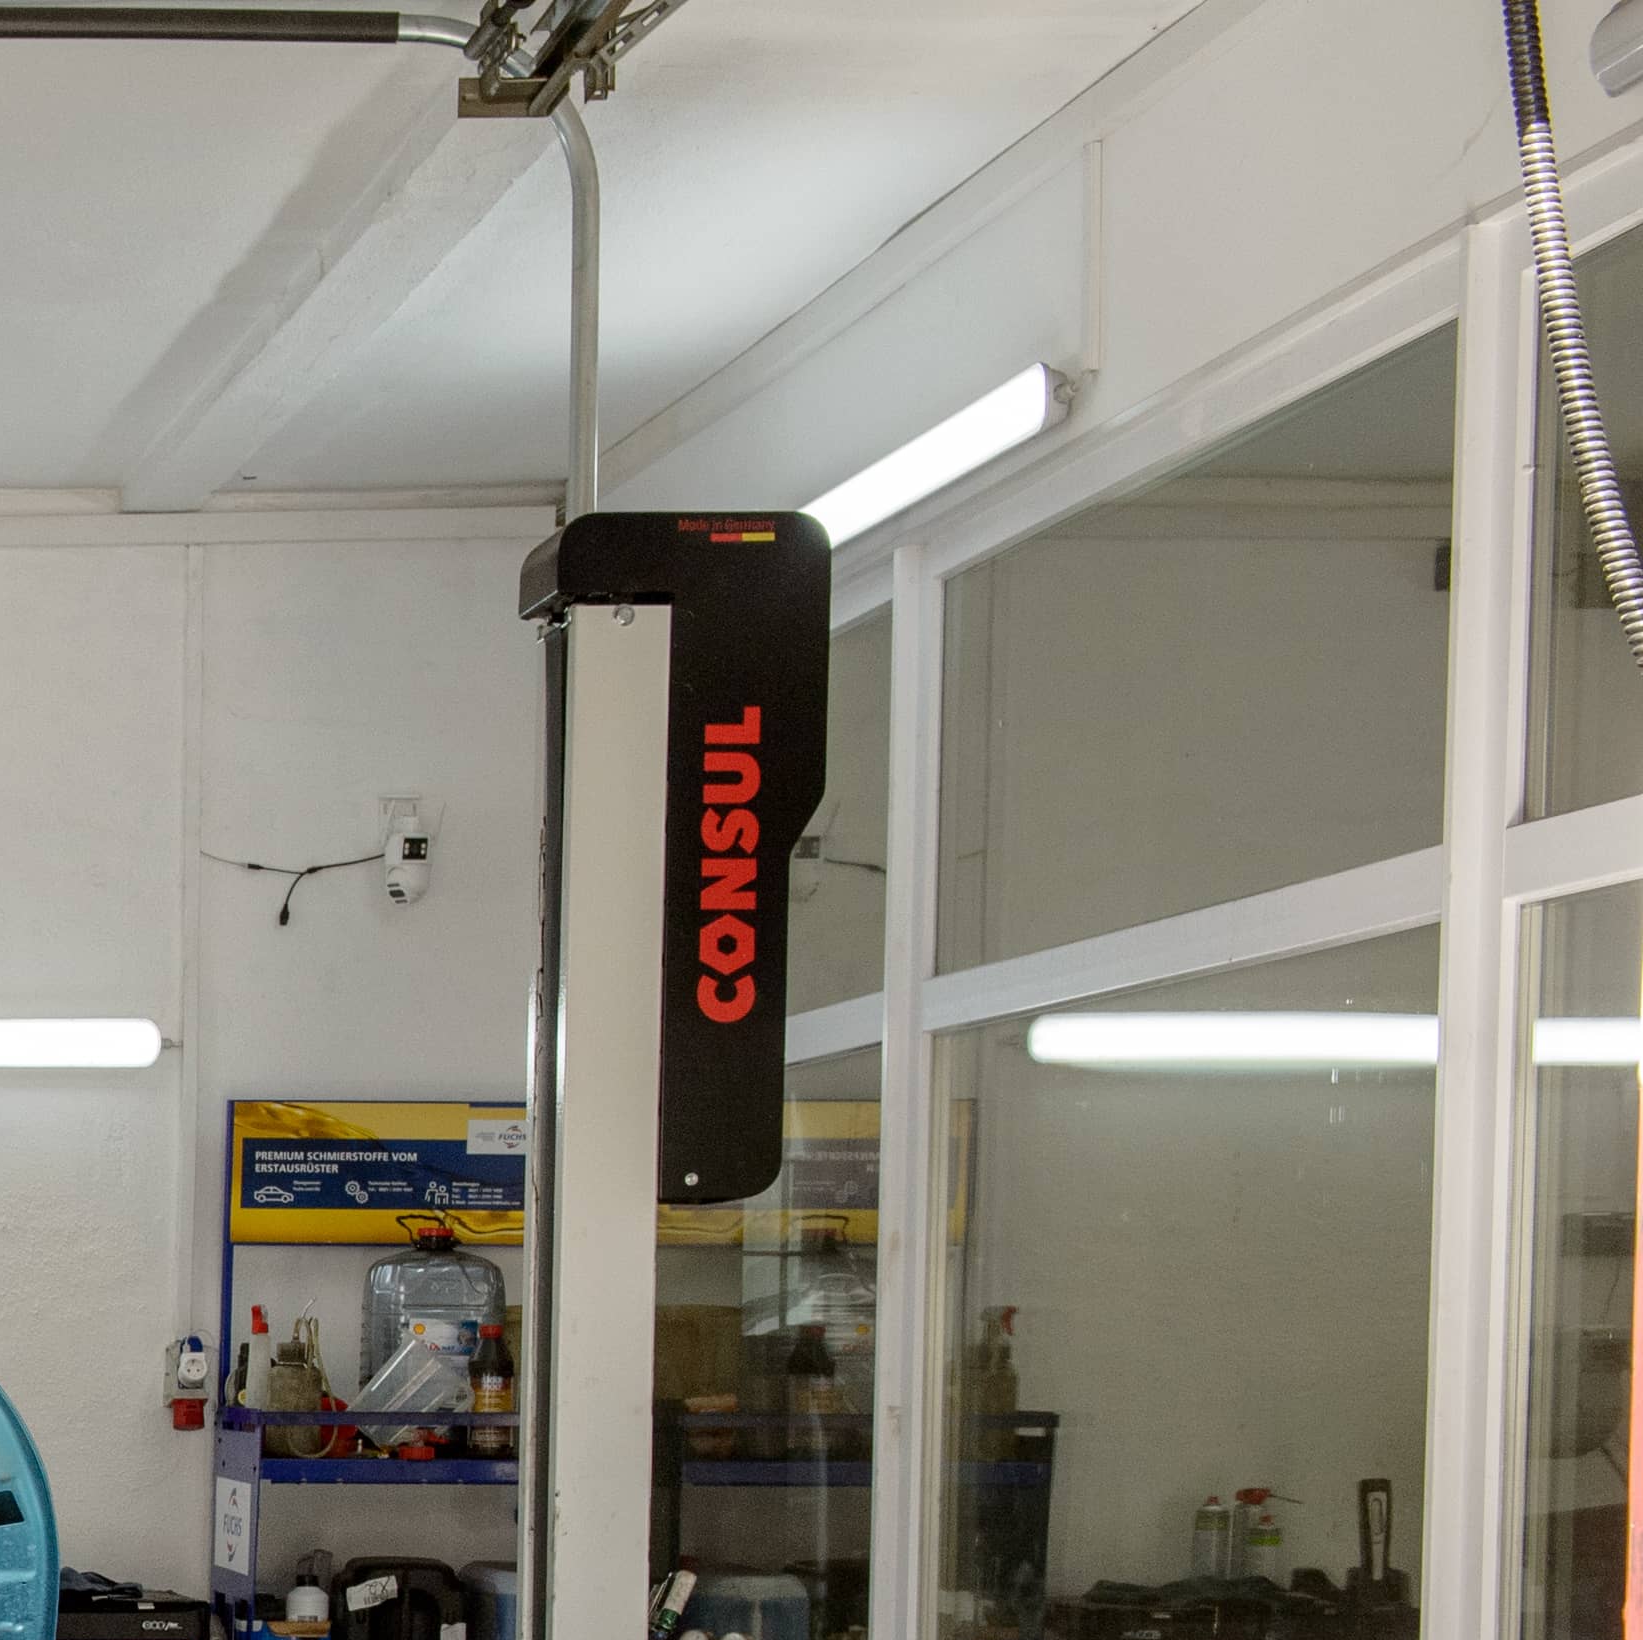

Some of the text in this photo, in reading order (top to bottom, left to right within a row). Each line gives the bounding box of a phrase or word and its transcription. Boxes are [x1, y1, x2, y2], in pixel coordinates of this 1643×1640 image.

[697, 706, 762, 1023] CONSUL
[255, 1151, 418, 1162] PREMIUM SCHMIERSTOFFE VOM
[254, 1162, 339, 1174] ERSTAUSRÜSTER
[223, 1514, 243, 1537] FUCHS
